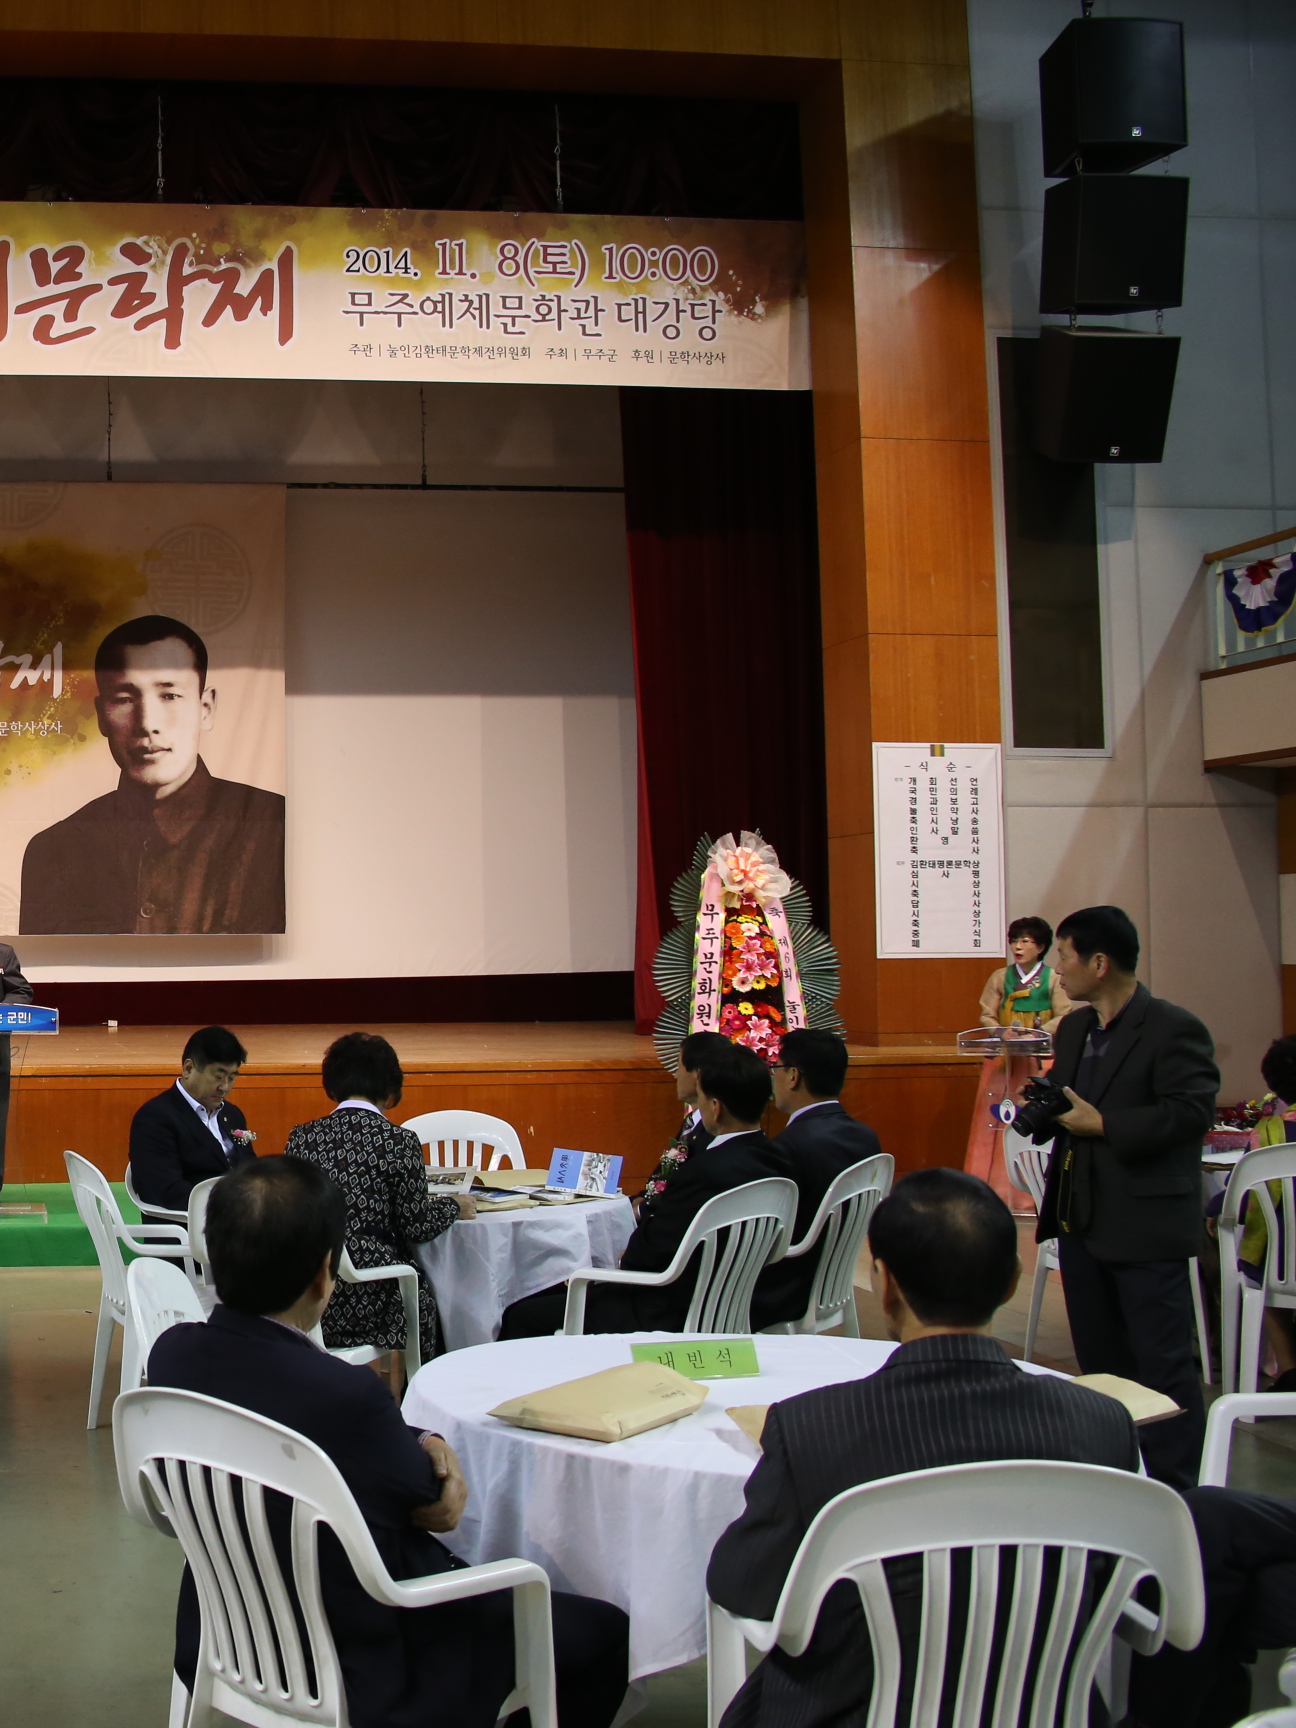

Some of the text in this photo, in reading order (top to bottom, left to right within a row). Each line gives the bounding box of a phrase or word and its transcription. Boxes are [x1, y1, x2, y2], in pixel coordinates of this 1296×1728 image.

[344, 239, 718, 287] 2014. 11. 8(토) 10:00
[343, 291, 723, 342] 무주예체문화관 대강당
[349, 343, 373, 358] 주관
[544, 347, 568, 360] 주최
[582, 348, 618, 362] 무주군
[631, 349, 654, 363] 후원
[667, 350, 726, 365] 문학사상사
[696, 903, 720, 1026] 무주문화원
[7, 1012, 31, 1024] 군민!
